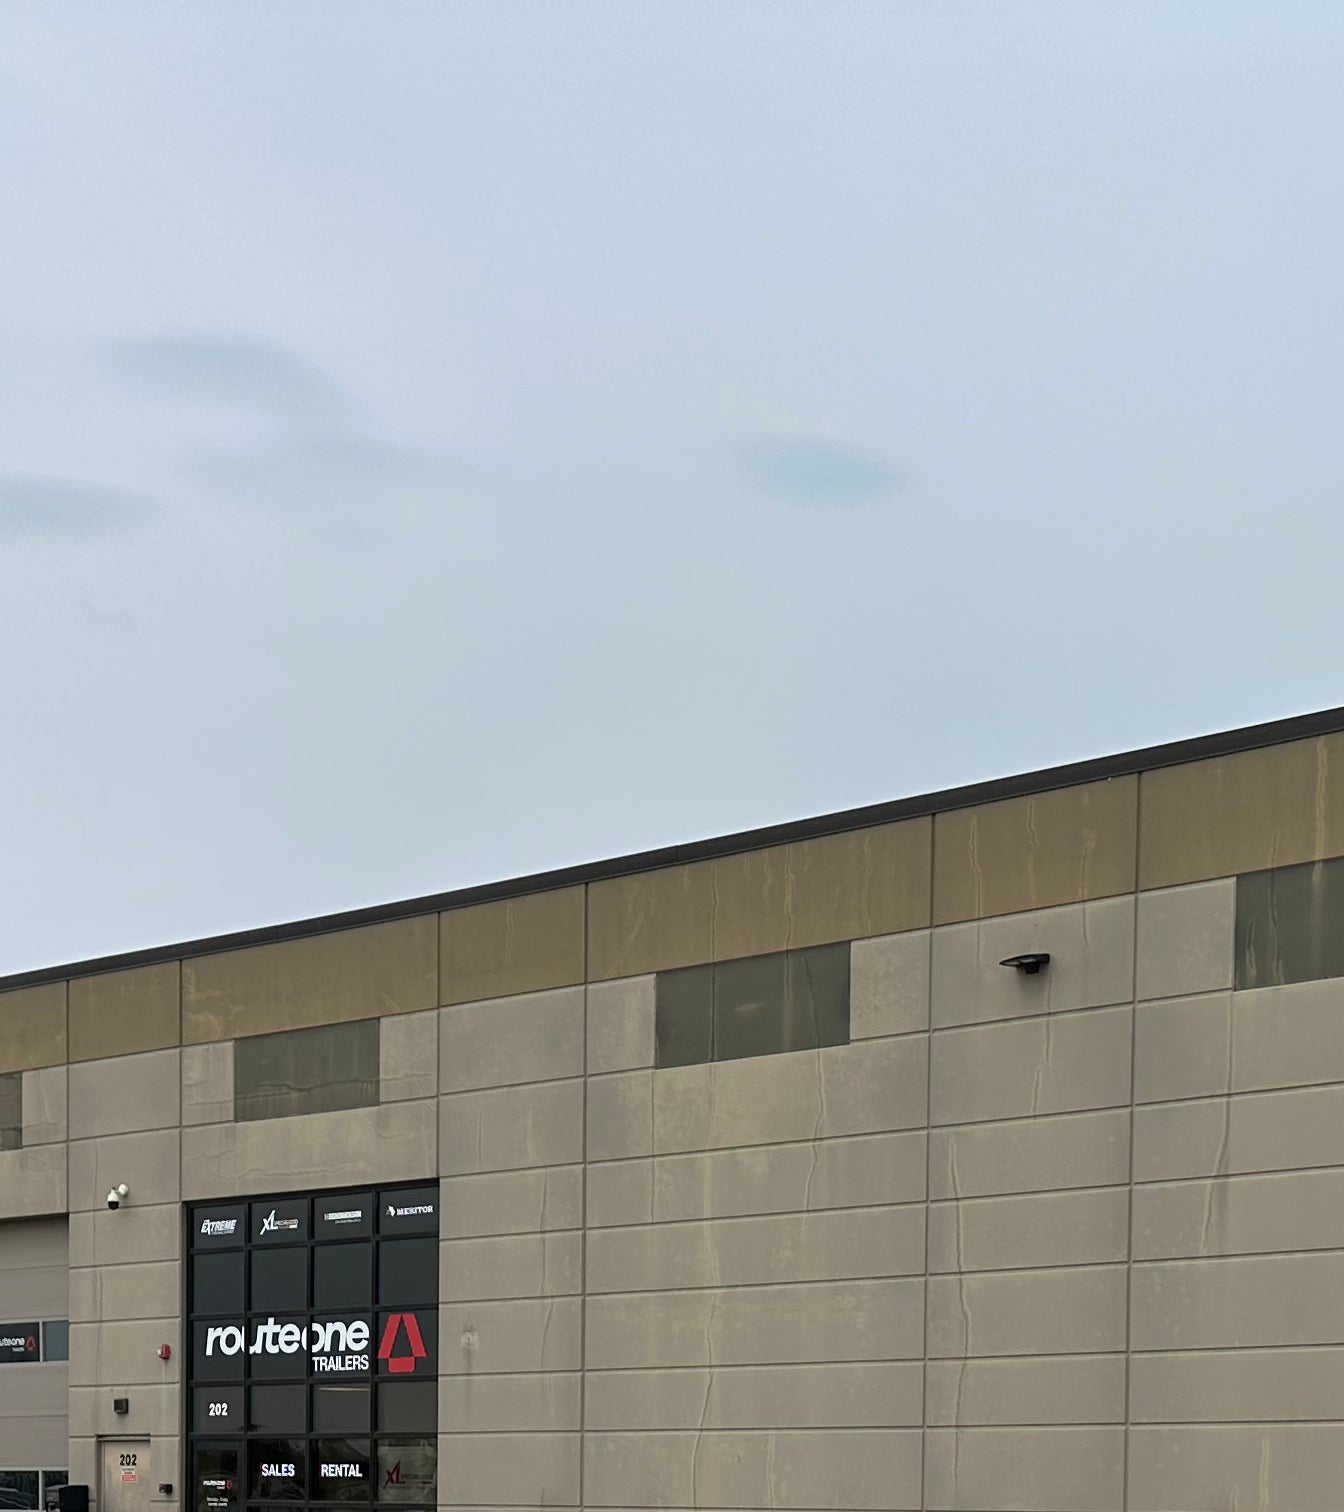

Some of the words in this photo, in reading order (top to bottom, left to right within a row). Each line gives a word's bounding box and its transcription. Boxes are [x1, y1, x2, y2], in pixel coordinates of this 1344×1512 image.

[206, 1317, 370, 1356] routeone
[312, 1355, 369, 1371] TRAILERS
[209, 1403, 228, 1416] 202
[119, 1454, 137, 1466] 202
[261, 1464, 295, 1477] SALES
[321, 1464, 362, 1477] RENTAL
